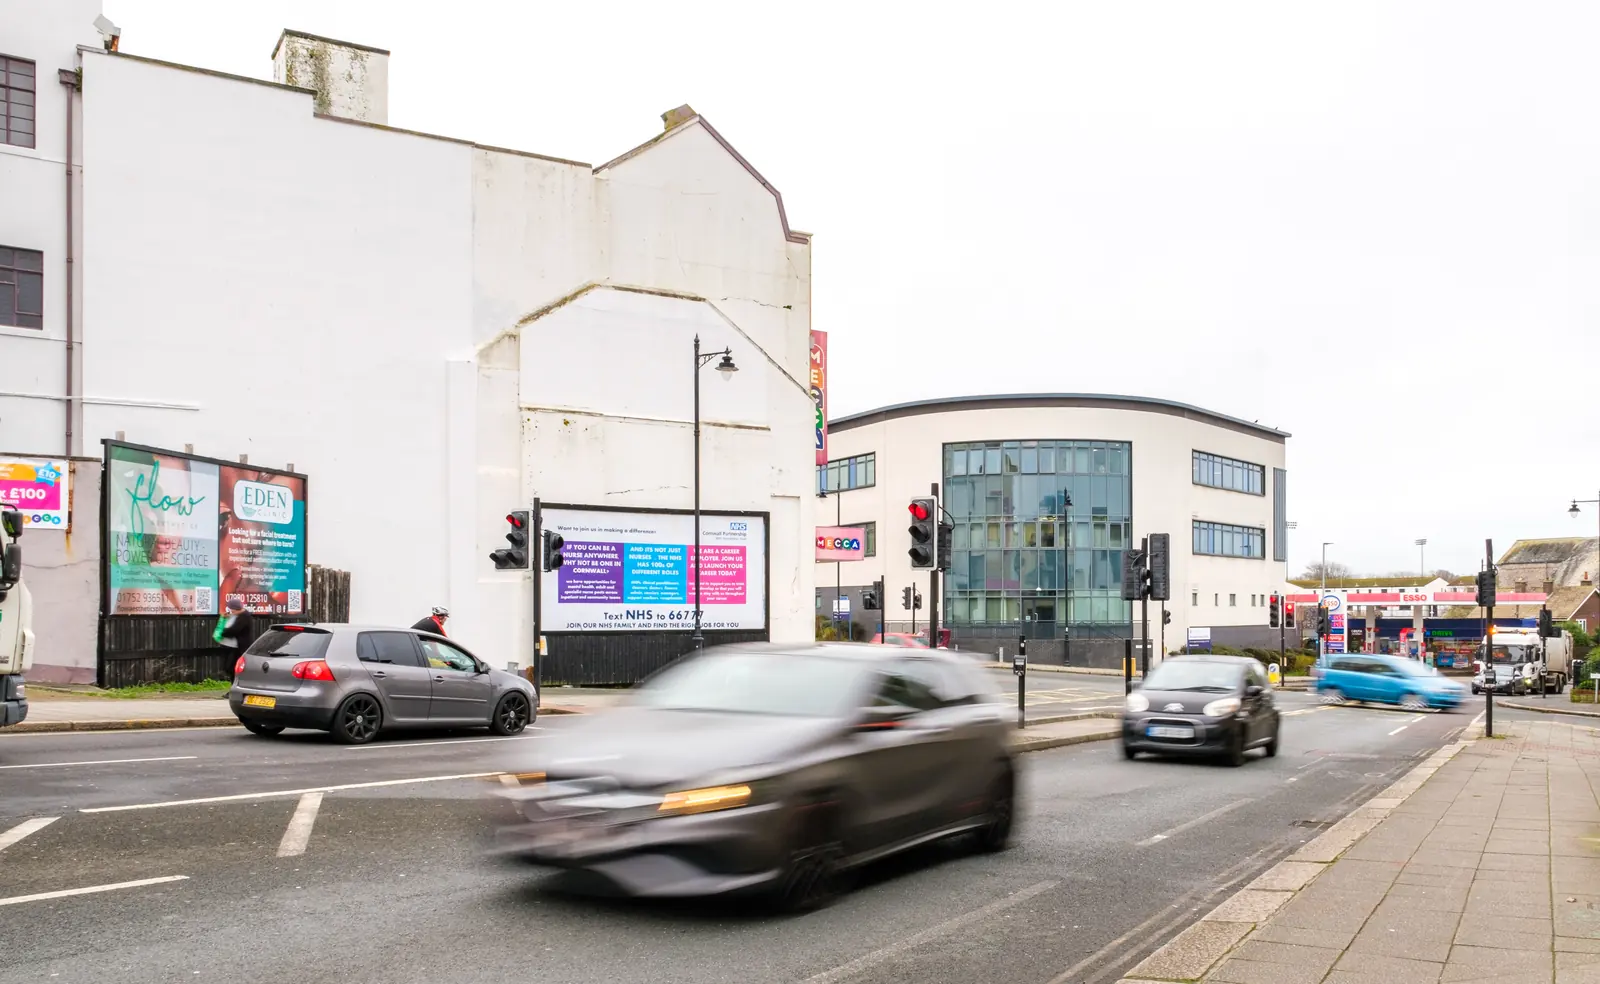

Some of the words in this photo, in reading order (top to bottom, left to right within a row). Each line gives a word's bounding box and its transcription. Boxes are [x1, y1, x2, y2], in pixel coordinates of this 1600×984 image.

[38, 468, 57, 480] £10
[10, 488, 46, 500] £100
[244, 486, 287, 508] EDEN
[125, 460, 205, 541] flow
[258, 509, 288, 518] CLINIC
[730, 522, 747, 530] NHS
[228, 528, 248, 537] Looking
[261, 530, 274, 538] facial
[274, 532, 296, 540] treatment
[166, 538, 200, 552] BEAUTY
[816, 538, 860, 550] MECCA
[156, 552, 168, 564] OF
[170, 552, 208, 566] SCIENCE
[117, 592, 140, 603] 01752
[246, 594, 268, 602] 125810
[626, 610, 653, 620] NHS
